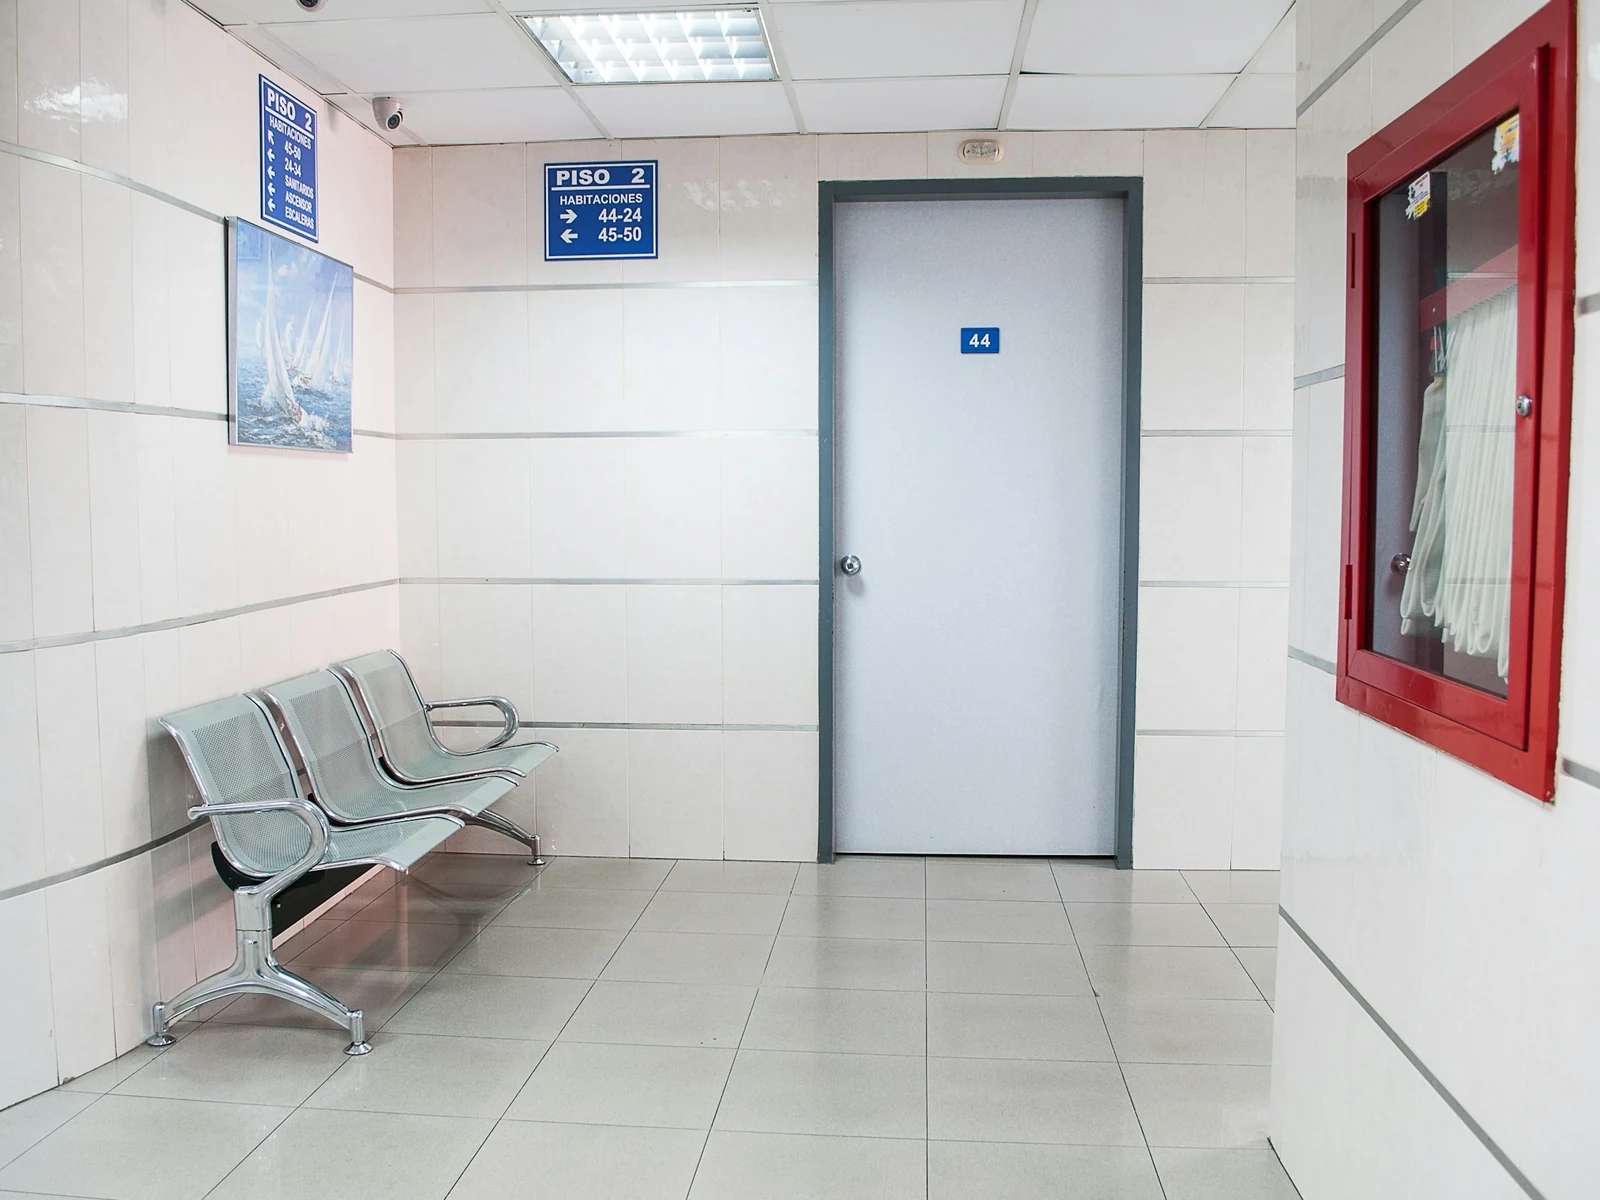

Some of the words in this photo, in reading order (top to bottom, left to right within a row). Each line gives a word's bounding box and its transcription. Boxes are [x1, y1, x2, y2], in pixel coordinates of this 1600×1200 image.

[267, 87, 296, 121] PISO
[305, 112, 313, 132] 2
[269, 115, 312, 149] HABITACIONES
[284, 141, 301, 160] 45-50
[284, 158, 301, 177] 24-34
[556, 169, 610, 185] PISO
[632, 168, 645, 183] 2
[284, 175, 314, 199] SANITARIOS
[285, 190, 313, 213] ASCENSOR
[560, 193, 643, 205] HABITACIONES
[285, 206, 314, 230] ESCALERAS
[598, 208, 642, 223] 44-24
[598, 226, 642, 242] 45-50
[969, 333, 991, 347] 44
